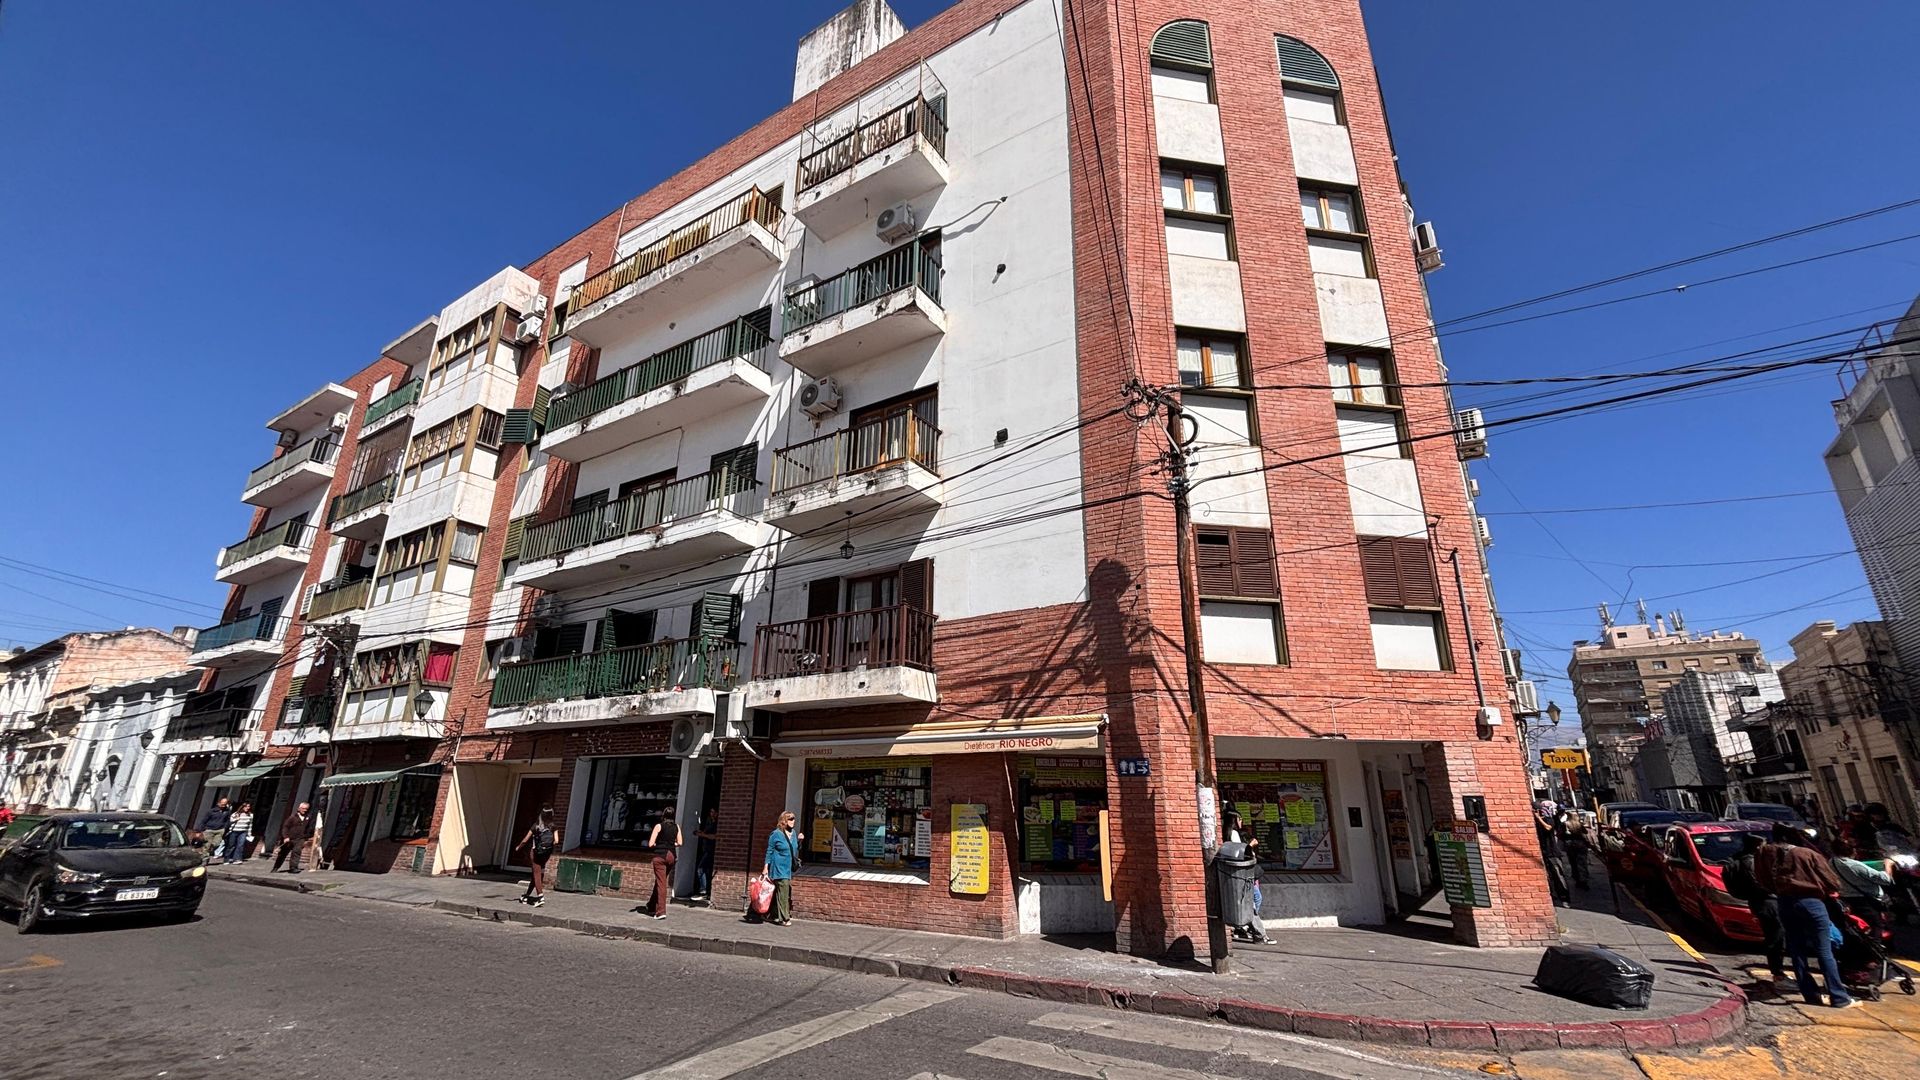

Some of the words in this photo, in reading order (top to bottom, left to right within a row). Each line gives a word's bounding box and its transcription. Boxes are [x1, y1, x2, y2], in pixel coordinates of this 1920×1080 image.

[964, 741, 995, 750] Dietética
[1000, 739, 1016, 749] RIO
[1018, 737, 1053, 748] NEGRO
[1549, 754, 1577, 763] Taxis
